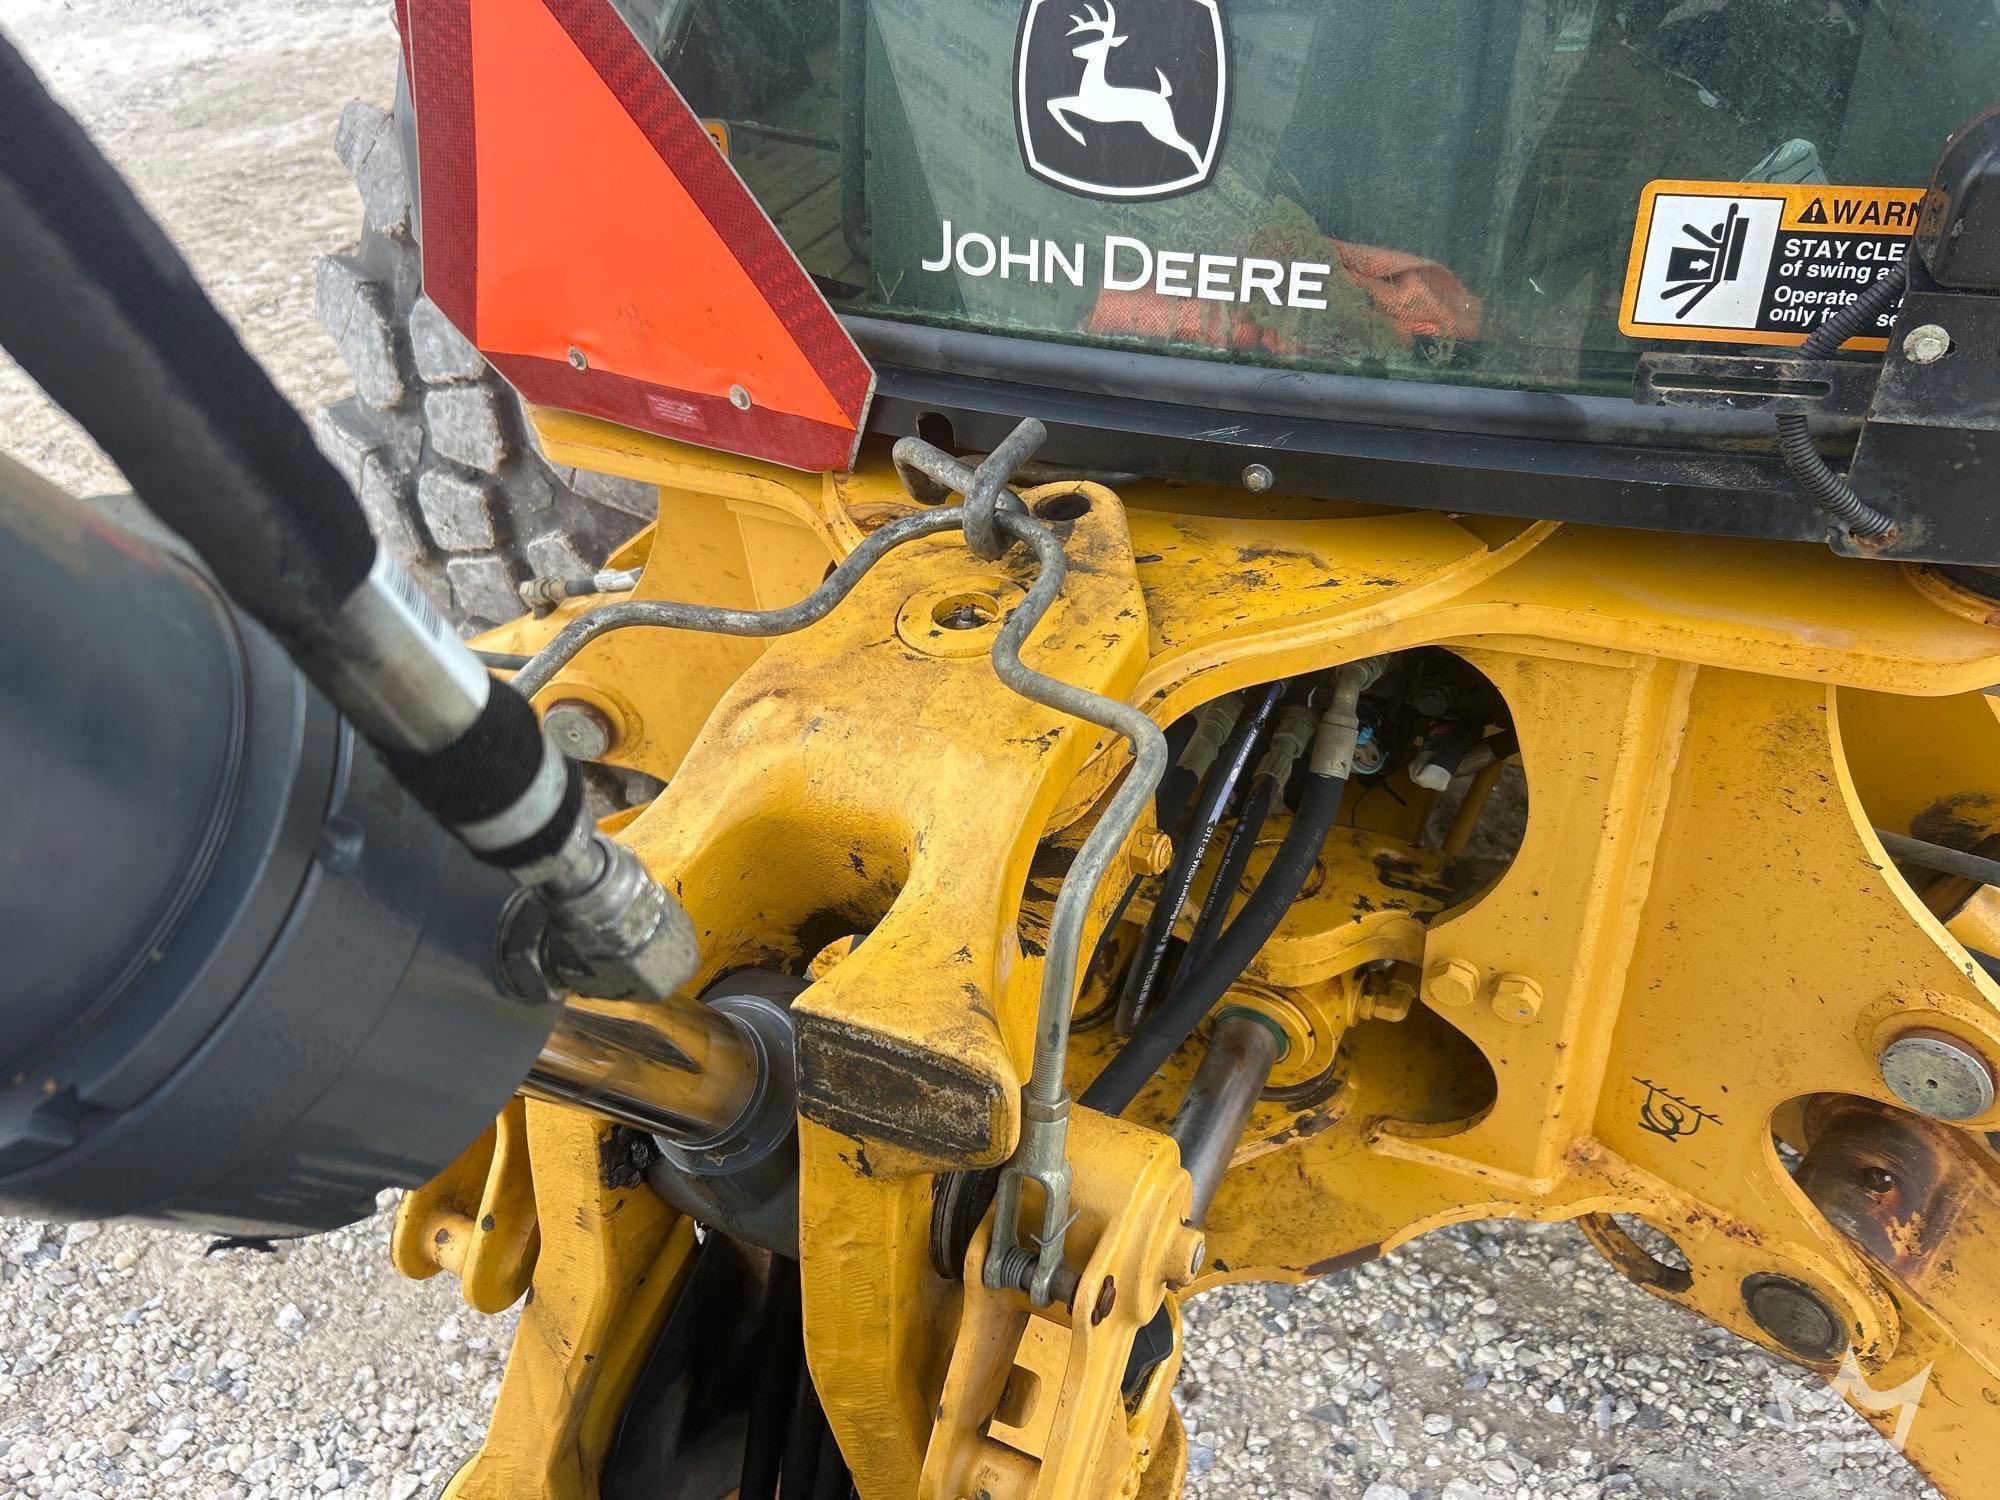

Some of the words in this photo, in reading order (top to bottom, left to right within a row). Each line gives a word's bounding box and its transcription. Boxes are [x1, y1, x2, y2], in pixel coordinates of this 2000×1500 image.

[1784, 238, 1850, 259] STAY
[921, 219, 1085, 287] JOHN
[1103, 235, 1331, 310] DEERE
[1779, 260, 1803, 277] of
[1806, 262, 1872, 284] swing
[1774, 285, 1858, 307] Operate
[1769, 306, 1816, 326] only
[1160, 919, 1176, 943] Flame
[1170, 883, 1190, 920] Resistant
[1185, 859, 1201, 883] MSHA
[1195, 826, 1214, 859] 2G-11C
